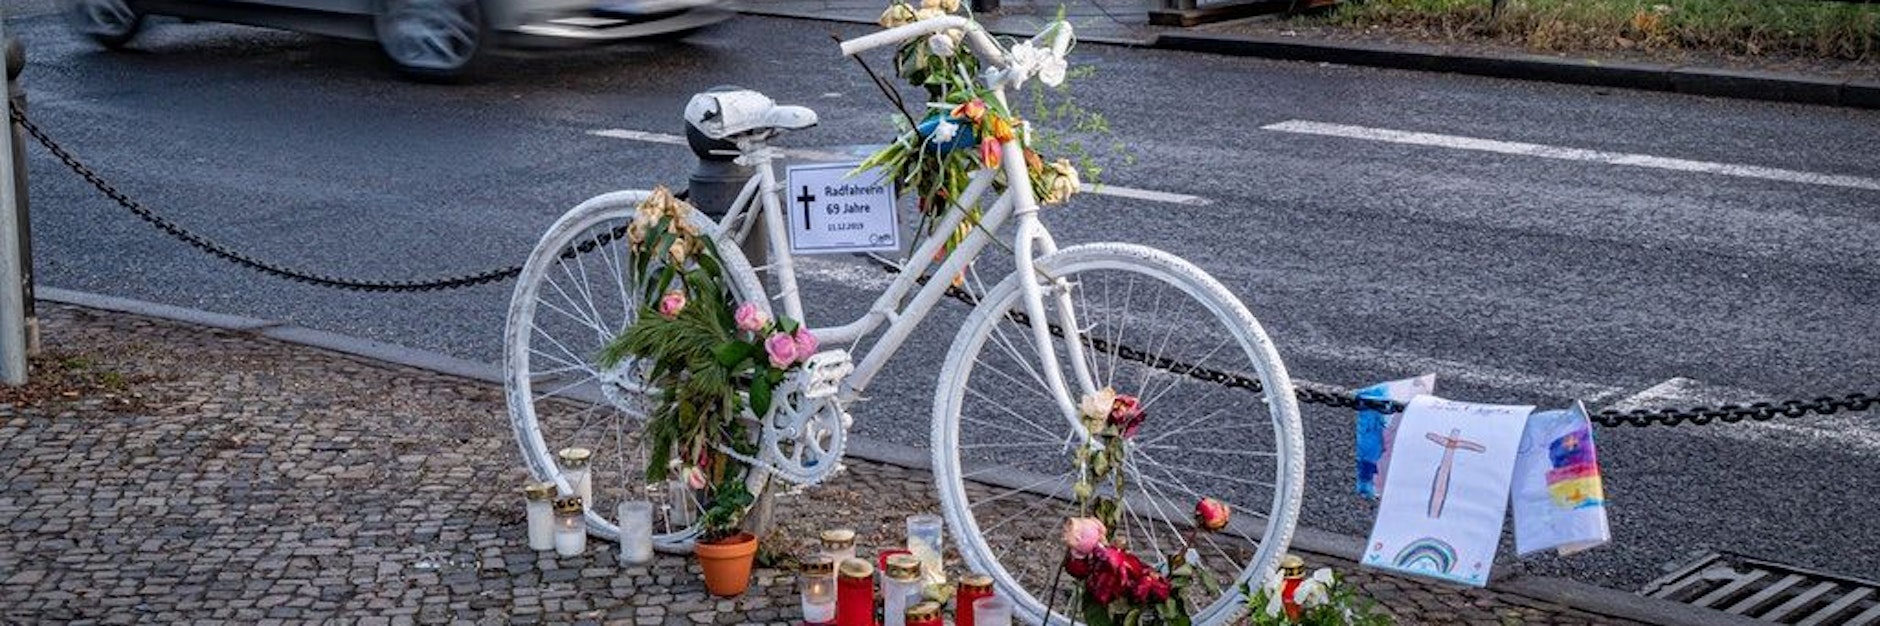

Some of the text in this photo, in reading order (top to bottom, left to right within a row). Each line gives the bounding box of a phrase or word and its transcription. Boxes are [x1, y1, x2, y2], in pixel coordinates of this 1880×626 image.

[824, 184, 884, 197] Radfahrerin
[826, 202, 871, 215] 69 Jahre
